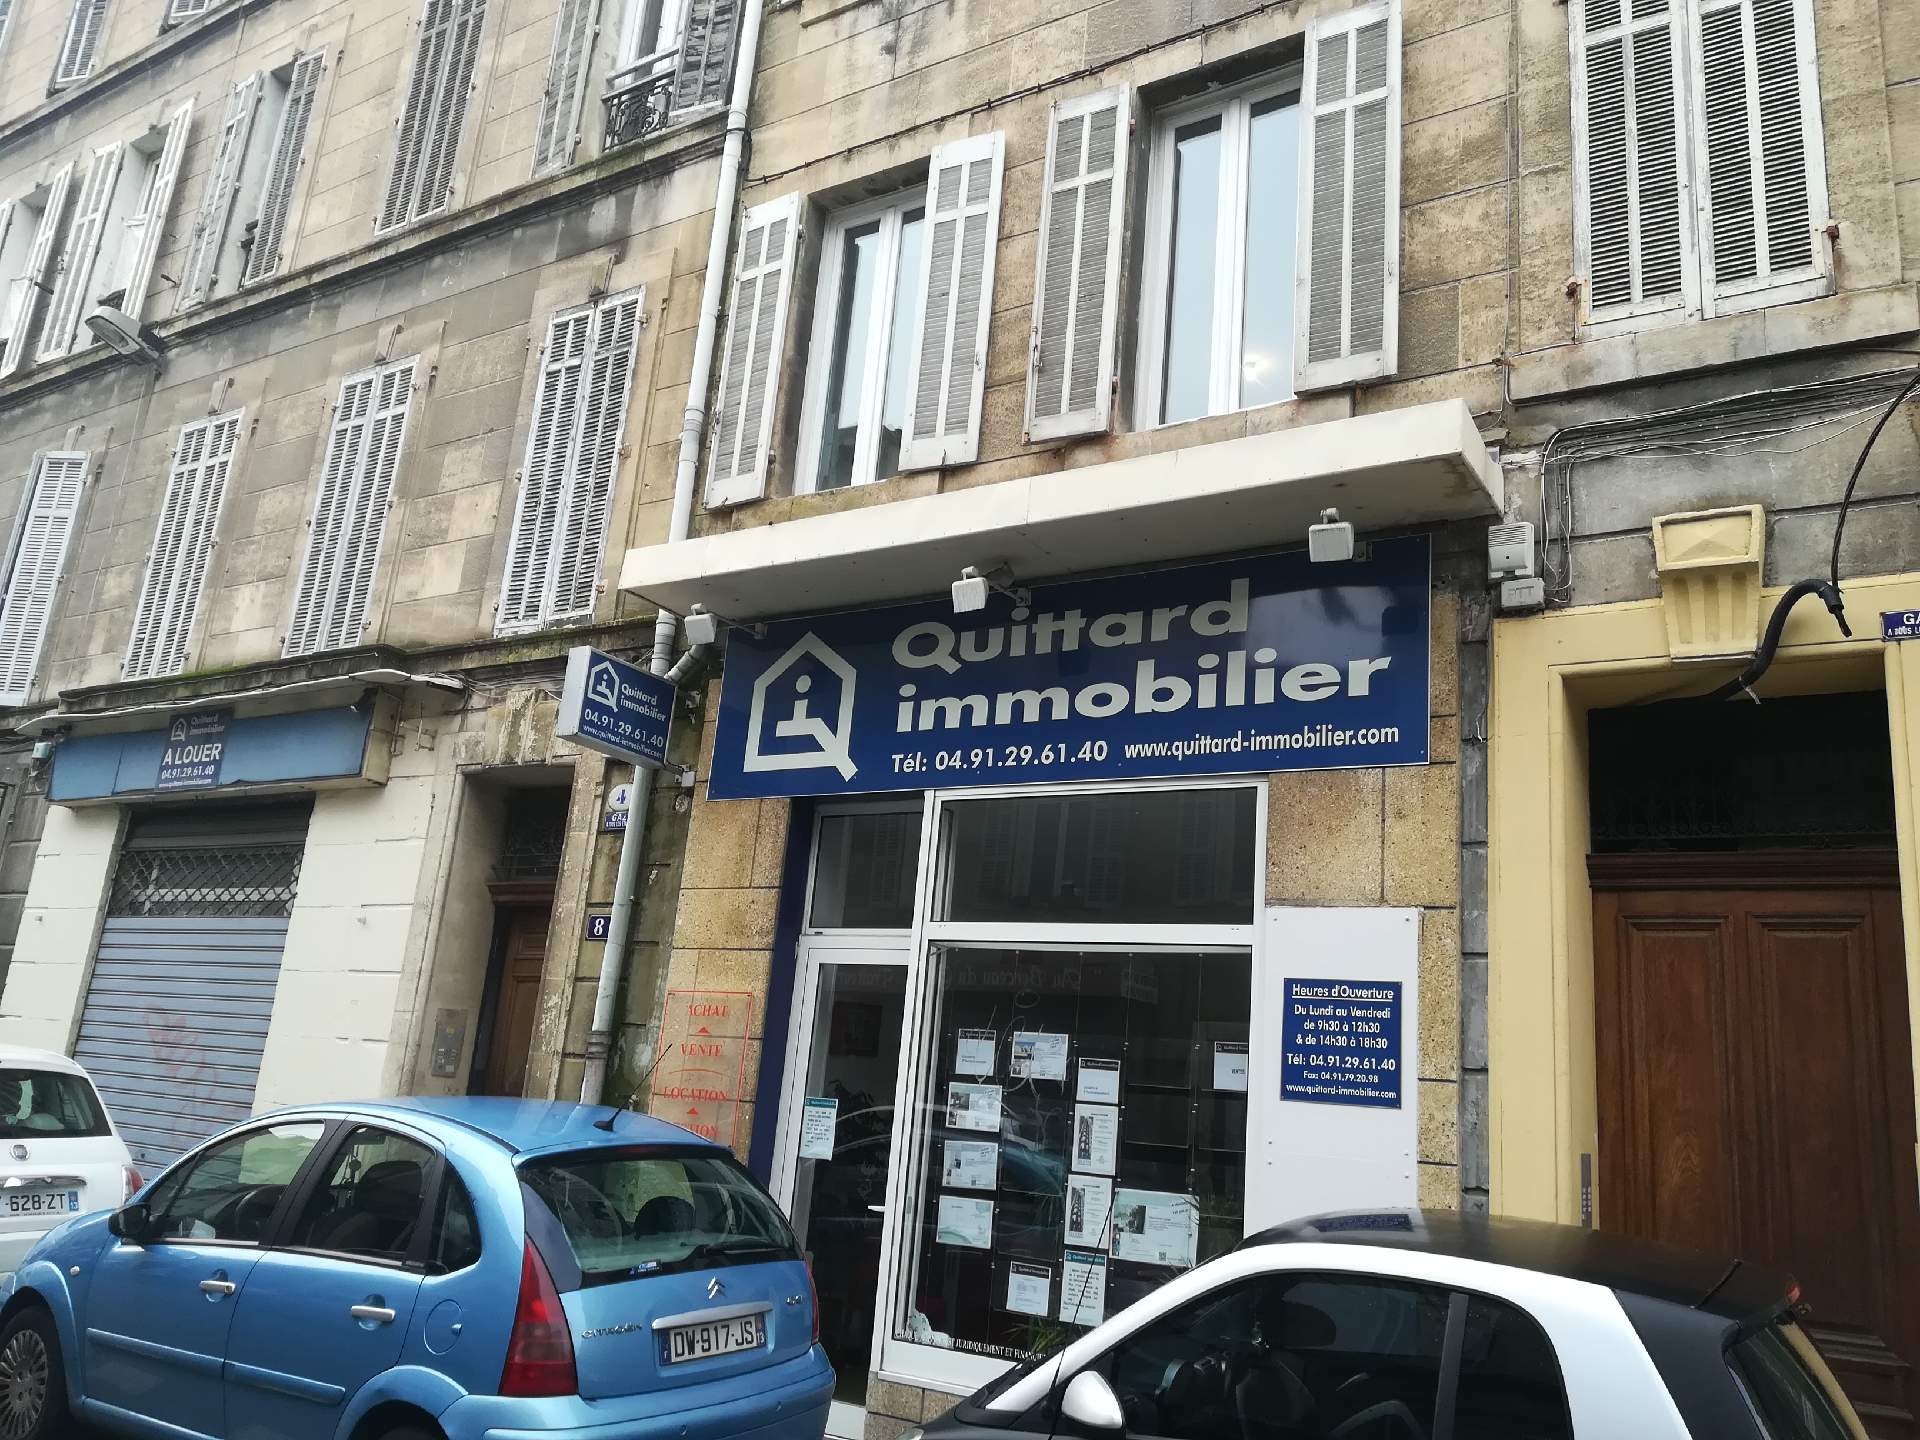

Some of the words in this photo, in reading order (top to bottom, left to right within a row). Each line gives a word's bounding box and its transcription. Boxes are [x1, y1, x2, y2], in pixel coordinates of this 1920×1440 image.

[892, 578, 1250, 674] Quittard
[621, 683, 658, 706] Quittard
[896, 648, 1392, 732] immobilier
[620, 695, 667, 722] immobilier
[584, 708, 664, 748] 04.91.29.61.40
[162, 748, 172, 766] A
[175, 743, 222, 765] LOUER
[891, 752, 928, 774] Tél:
[935, 740, 1109, 771] 04.91.29.61.40
[1124, 723, 1399, 761] www.quittard-immobilier.com
[161, 764, 215, 780] 04.91.29.61.40
[593, 918, 605, 936] 8
[1292, 984, 1329, 997] Heures
[1331, 984, 1394, 999] d'Ouverture
[1294, 1004, 1307, 1015] Du
[1309, 1005, 1333, 1016] Lundi
[1336, 1008, 1347, 1016] au
[1350, 1006, 1391, 1019] Vendredi
[1303, 1019, 1315, 1030] de
[1318, 1020, 1340, 1031] 9h30
[1342, 1021, 1349, 1032] à
[1352, 1021, 1380, 1033] 12h30
[1296, 1034, 1303, 1045] &
[1305, 1034, 1316, 1045] de
[1320, 1035, 1347, 1047] 14h30
[1349, 1036, 1356, 1047] à
[1359, 1037, 1388, 1049] 18h30
[1287, 1053, 1306, 1065] Tél:
[1309, 1054, 1396, 1071] 04.91.29.61.40
[1303, 1071, 1319, 1079] Fax:
[1320, 1072, 1379, 1083] 04.91.79.20.98
[1286, 1084, 1397, 1099] www.quittard-immobilier.com
[673, 1320, 755, 1358] DW-917-JS
